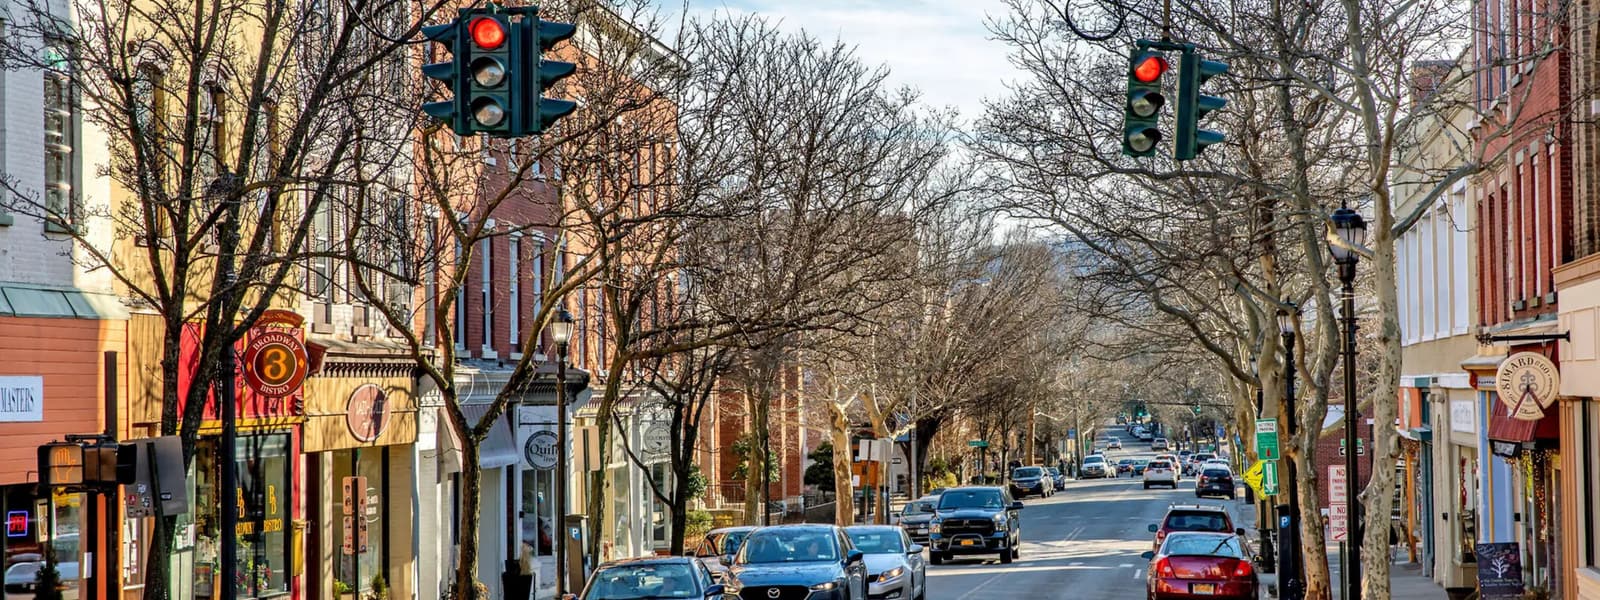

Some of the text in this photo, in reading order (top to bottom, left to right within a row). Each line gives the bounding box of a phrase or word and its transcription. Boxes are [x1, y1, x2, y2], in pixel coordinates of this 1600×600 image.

[252, 334, 300, 351] BROADWAY
[264, 348, 287, 380] 3
[1501, 357, 1534, 390] SIMARD
[260, 384, 290, 395] BISTRO
[0, 387, 34, 413] MASTERS
[1336, 469, 1345, 477] NO
[264, 518, 282, 533] BISTRO
